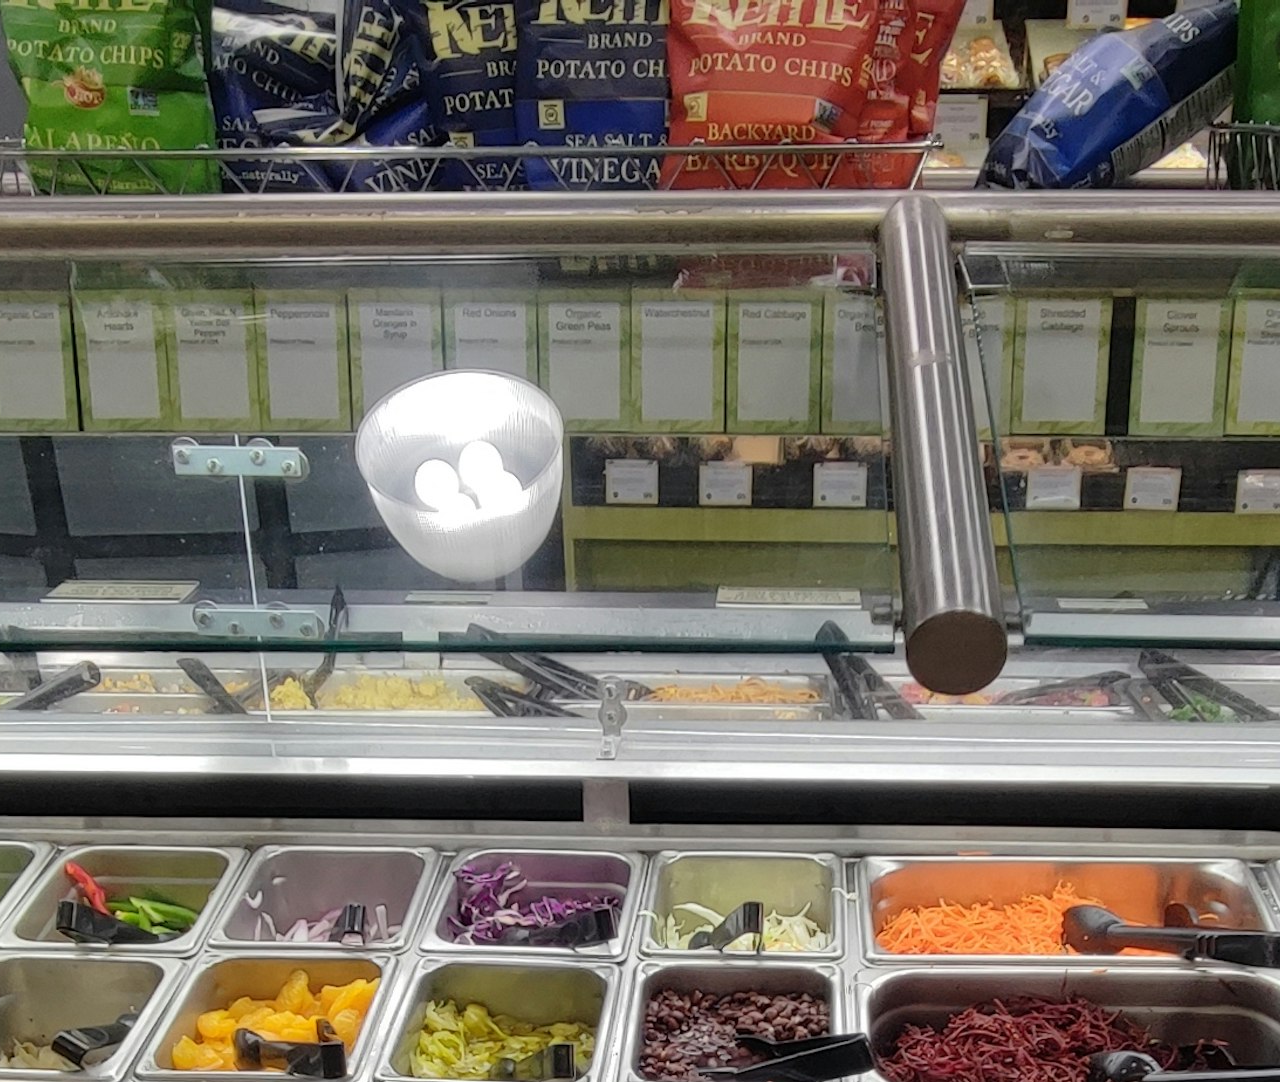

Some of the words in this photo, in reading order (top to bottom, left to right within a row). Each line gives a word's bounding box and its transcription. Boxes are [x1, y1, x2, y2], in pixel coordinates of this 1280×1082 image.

[58, 18, 117, 34] BRAND
[587, 32, 653, 49] BRAND
[737, 30, 806, 47] BRAND
[6, 38, 94, 64] POTATO
[99, 45, 165, 69] CHIPS
[535, 58, 626, 79] POTATO
[688, 52, 777, 77] POTATO
[783, 57, 853, 87] CHIPS
[707, 122, 817, 143] BACKYARD
[462, 308, 481, 319] Red
[484, 308, 517, 318] Onions
[564, 309, 601, 320] Organic
[742, 308, 761, 319] Red
[764, 309, 807, 321] Cabbage
[1040, 307, 1086, 319] Shredded
[194, 328, 226, 338] Peppers
[556, 321, 585, 332] Green
[587, 321, 611, 332] Peas
[1162, 322, 1199, 334] Sprouts
[383, 330, 407, 340] Syrup
